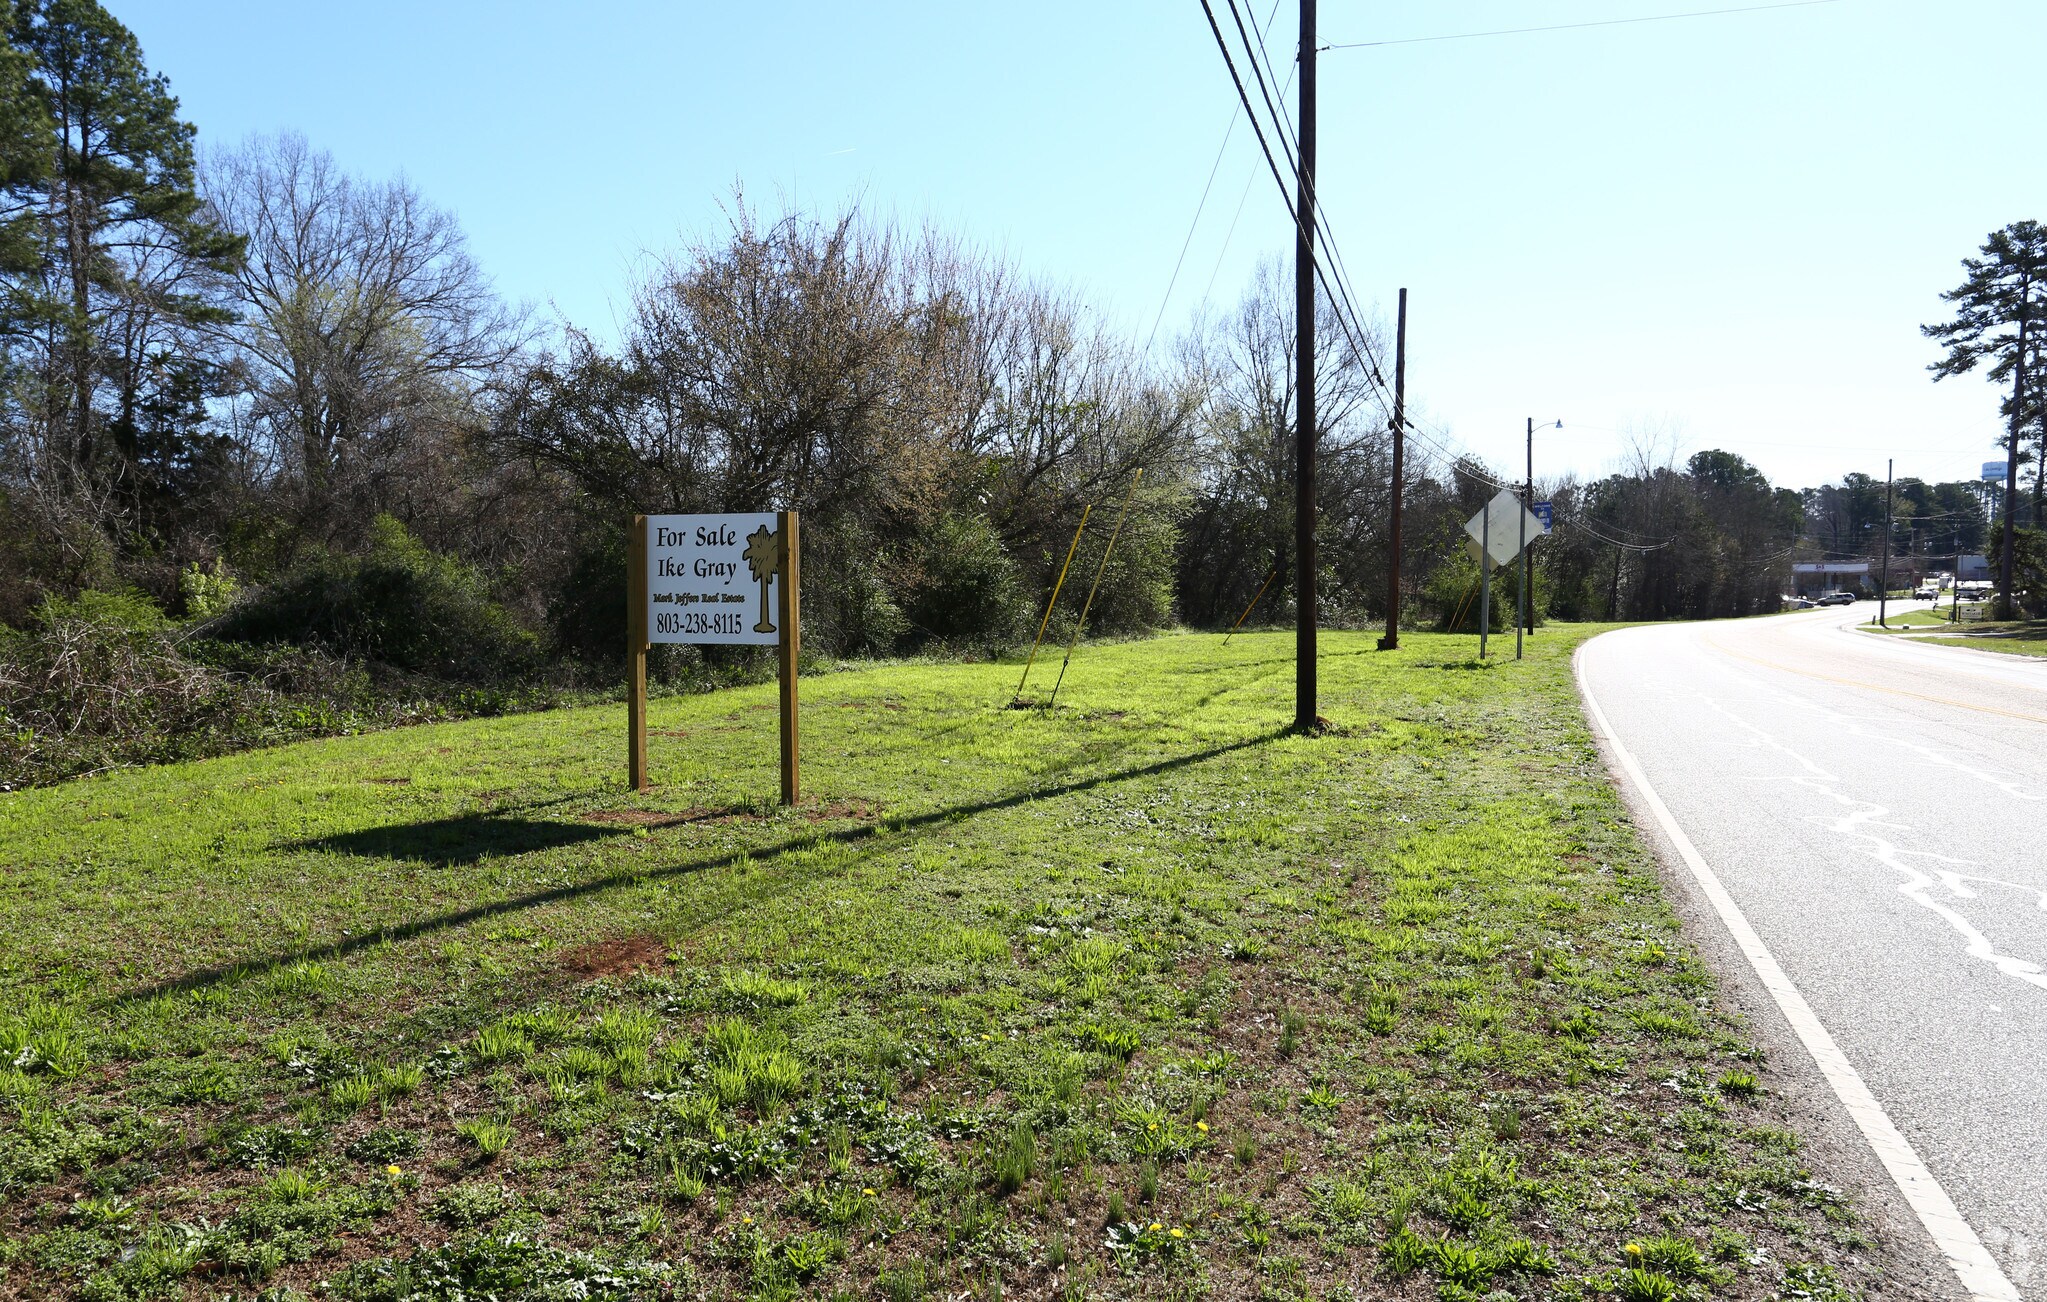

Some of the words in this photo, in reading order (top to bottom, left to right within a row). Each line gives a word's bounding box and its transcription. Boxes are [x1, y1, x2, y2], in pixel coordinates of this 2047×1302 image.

[656, 527, 686, 547] For
[695, 523, 737, 547] Sale
[657, 556, 686, 577] Ike
[693, 558, 737, 585] Gray
[701, 592, 720, 603] Real
[721, 593, 745, 603] Estate
[656, 613, 742, 634] 803-238-8115
